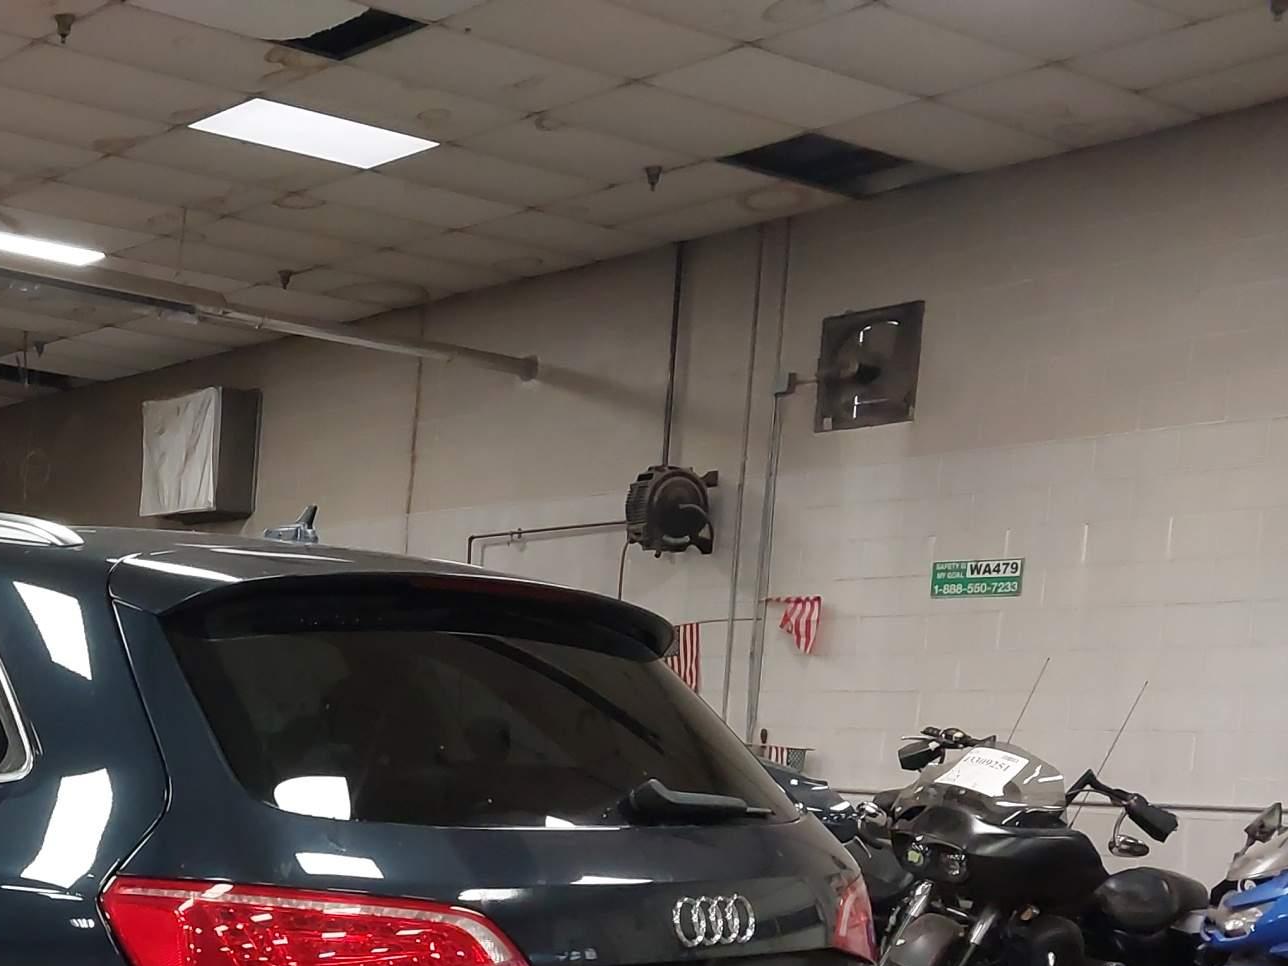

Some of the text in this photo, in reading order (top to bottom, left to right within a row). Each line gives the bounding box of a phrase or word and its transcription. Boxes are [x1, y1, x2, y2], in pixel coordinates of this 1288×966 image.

[935, 562, 960, 570] SAFETY
[969, 561, 1019, 576] WA479
[936, 571, 946, 579] MY
